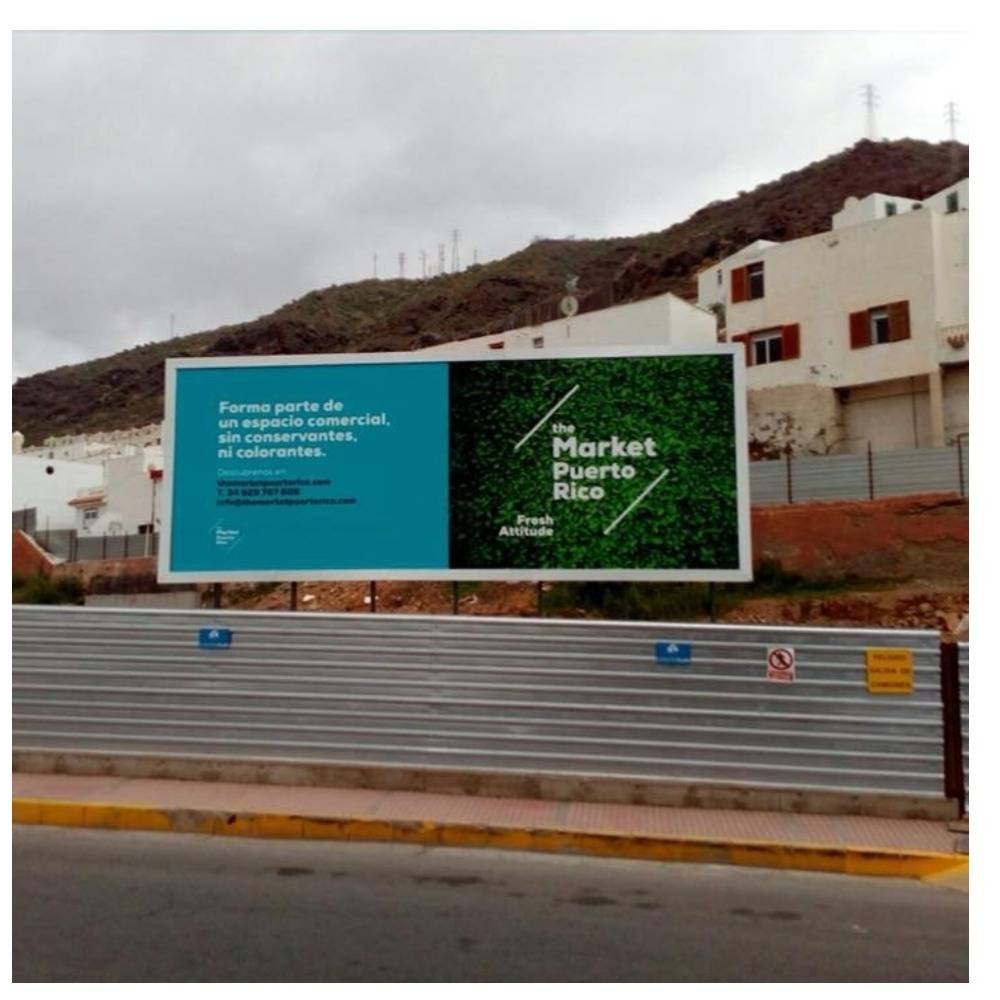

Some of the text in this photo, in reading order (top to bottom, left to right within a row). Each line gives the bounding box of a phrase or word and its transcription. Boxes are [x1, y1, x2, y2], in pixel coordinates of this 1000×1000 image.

[218, 399, 343, 416] Forma parte de
[218, 413, 391, 431] un espacio comercial,
[552, 423, 576, 434] the
[217, 431, 241, 444] sin
[217, 445, 327, 459] ni colorantes.
[552, 435, 658, 459] Market
[552, 461, 637, 481] Puerto
[553, 481, 605, 501] Rico
[516, 514, 554, 526] Fresh
[498, 525, 554, 537] Attitude
